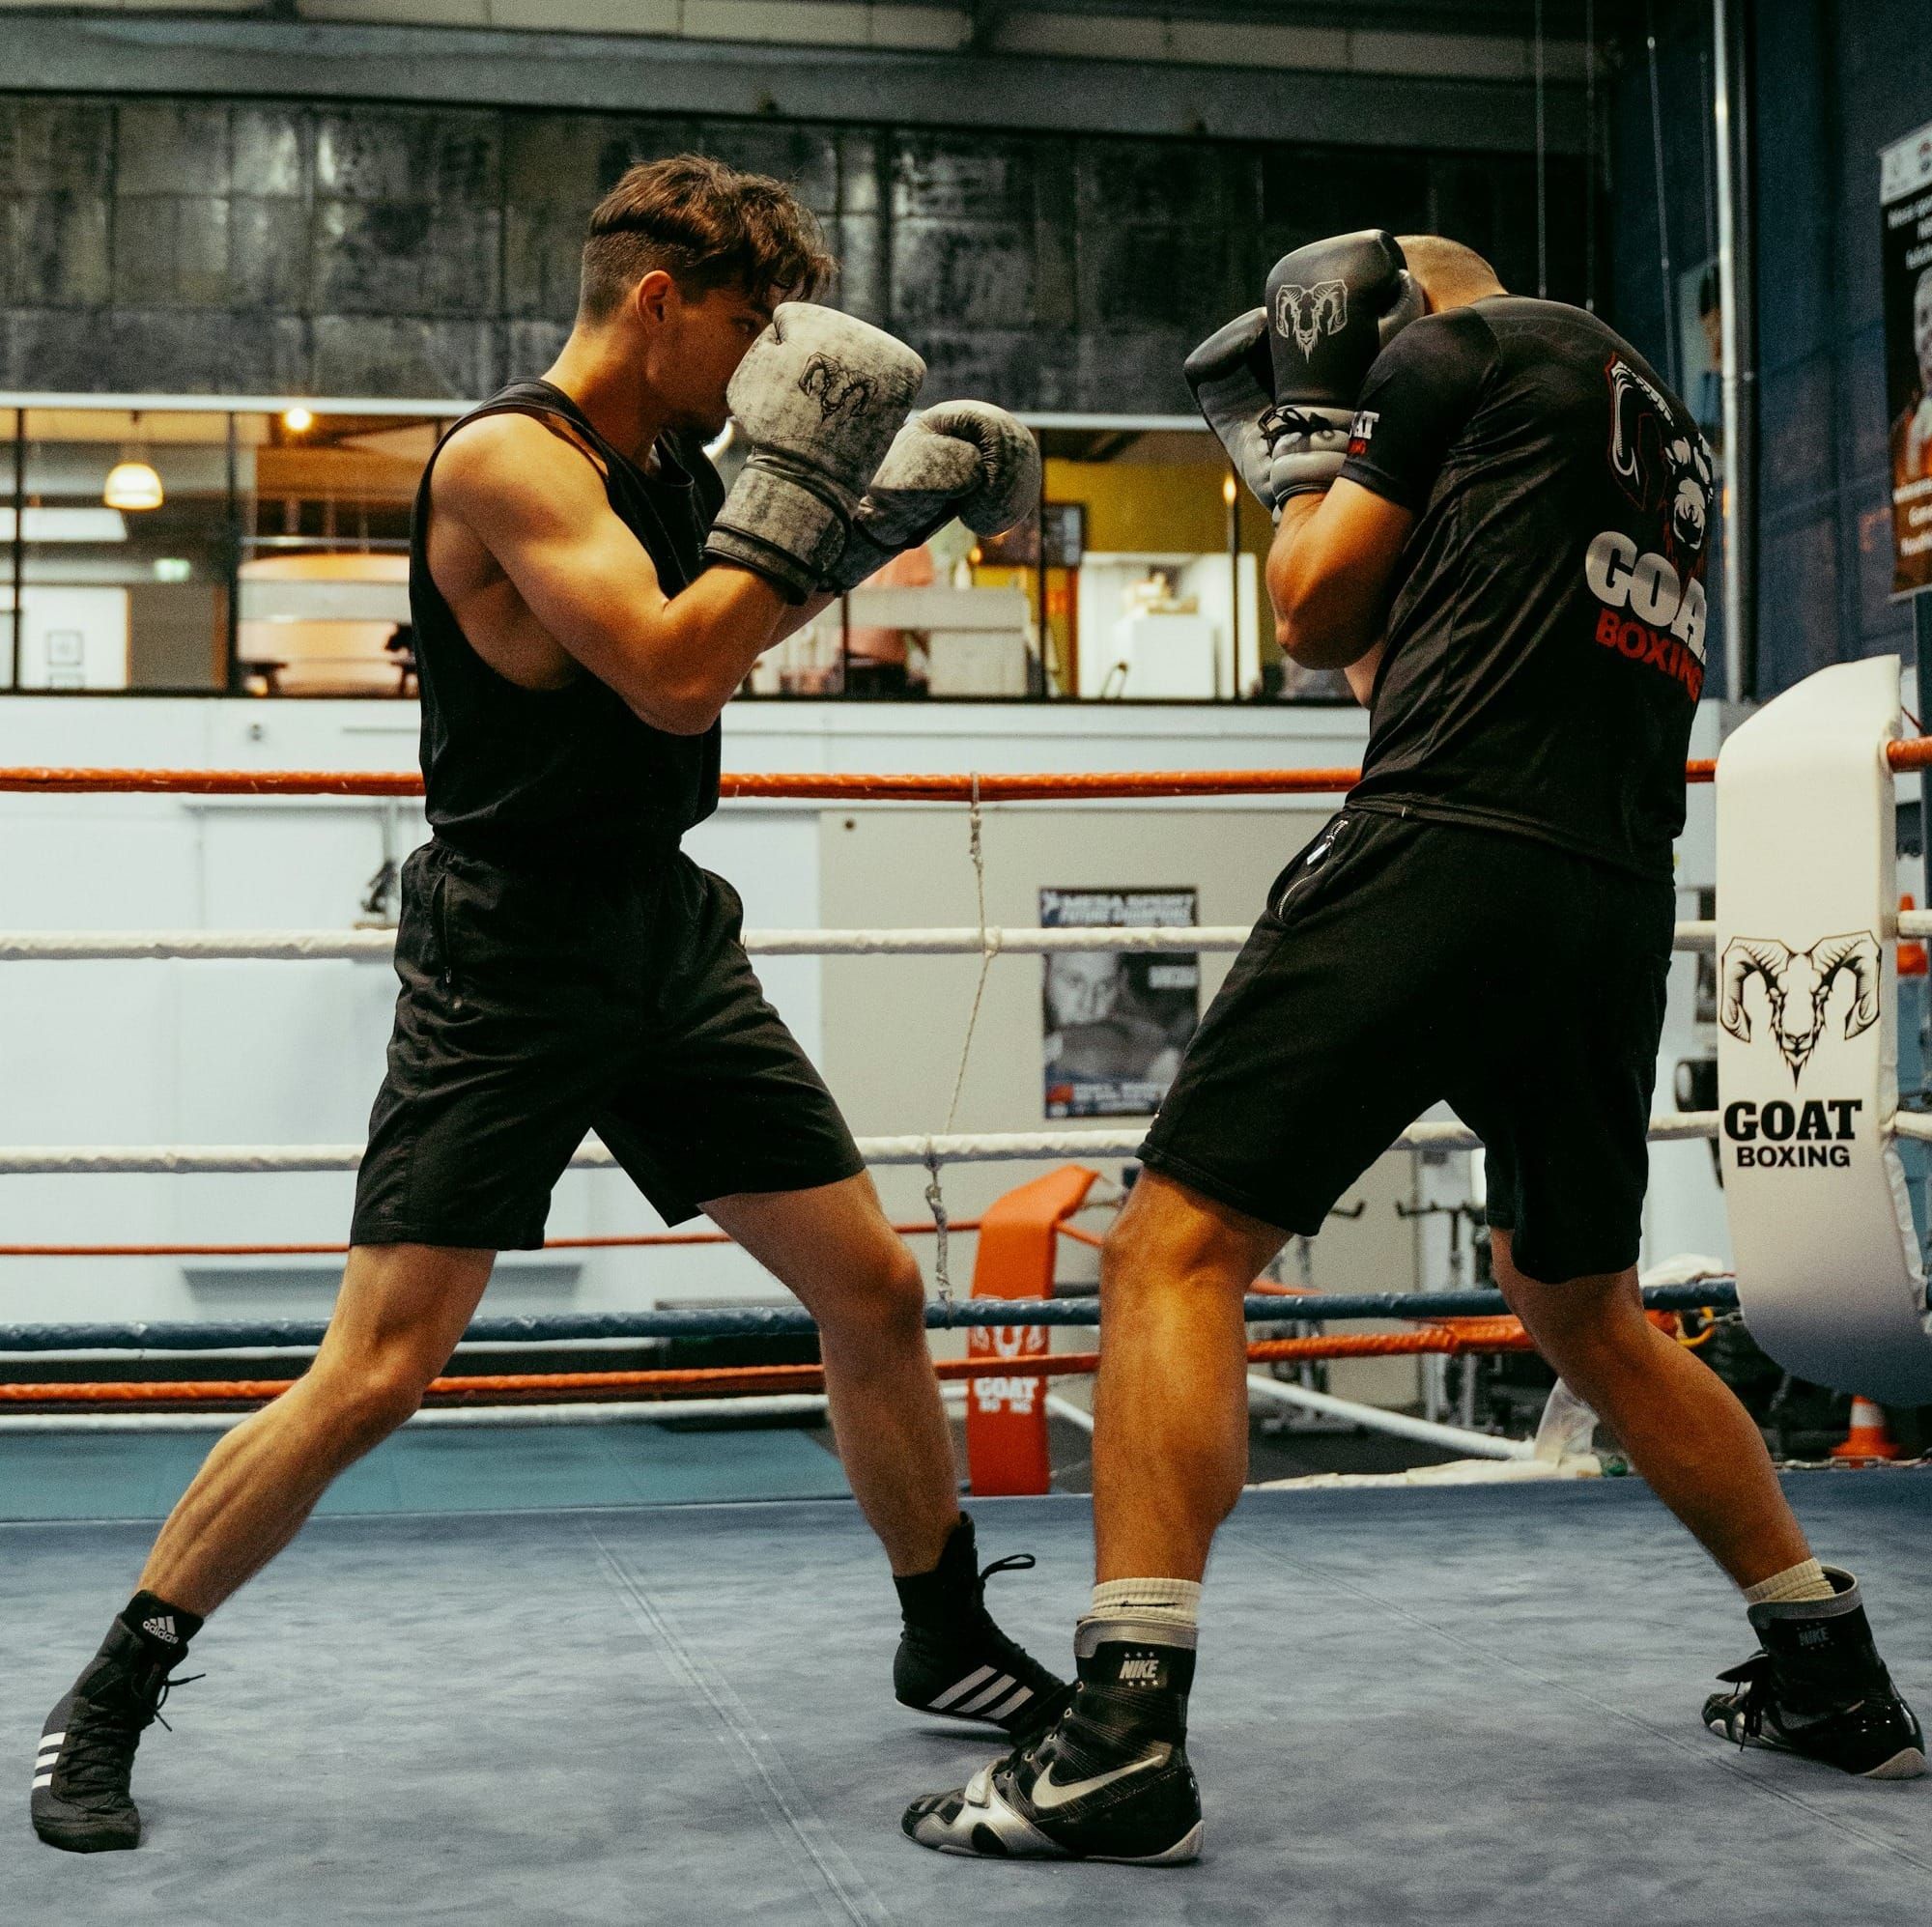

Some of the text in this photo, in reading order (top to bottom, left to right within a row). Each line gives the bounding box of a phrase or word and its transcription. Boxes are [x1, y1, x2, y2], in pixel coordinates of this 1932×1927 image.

[1585, 530, 1707, 665] GOA
[1724, 1099, 1862, 1141] GOAT
[1737, 1147, 1850, 1168] BOXING
[142, 1620, 180, 1645] adidas
[1119, 1659, 1159, 1679] NIKE
